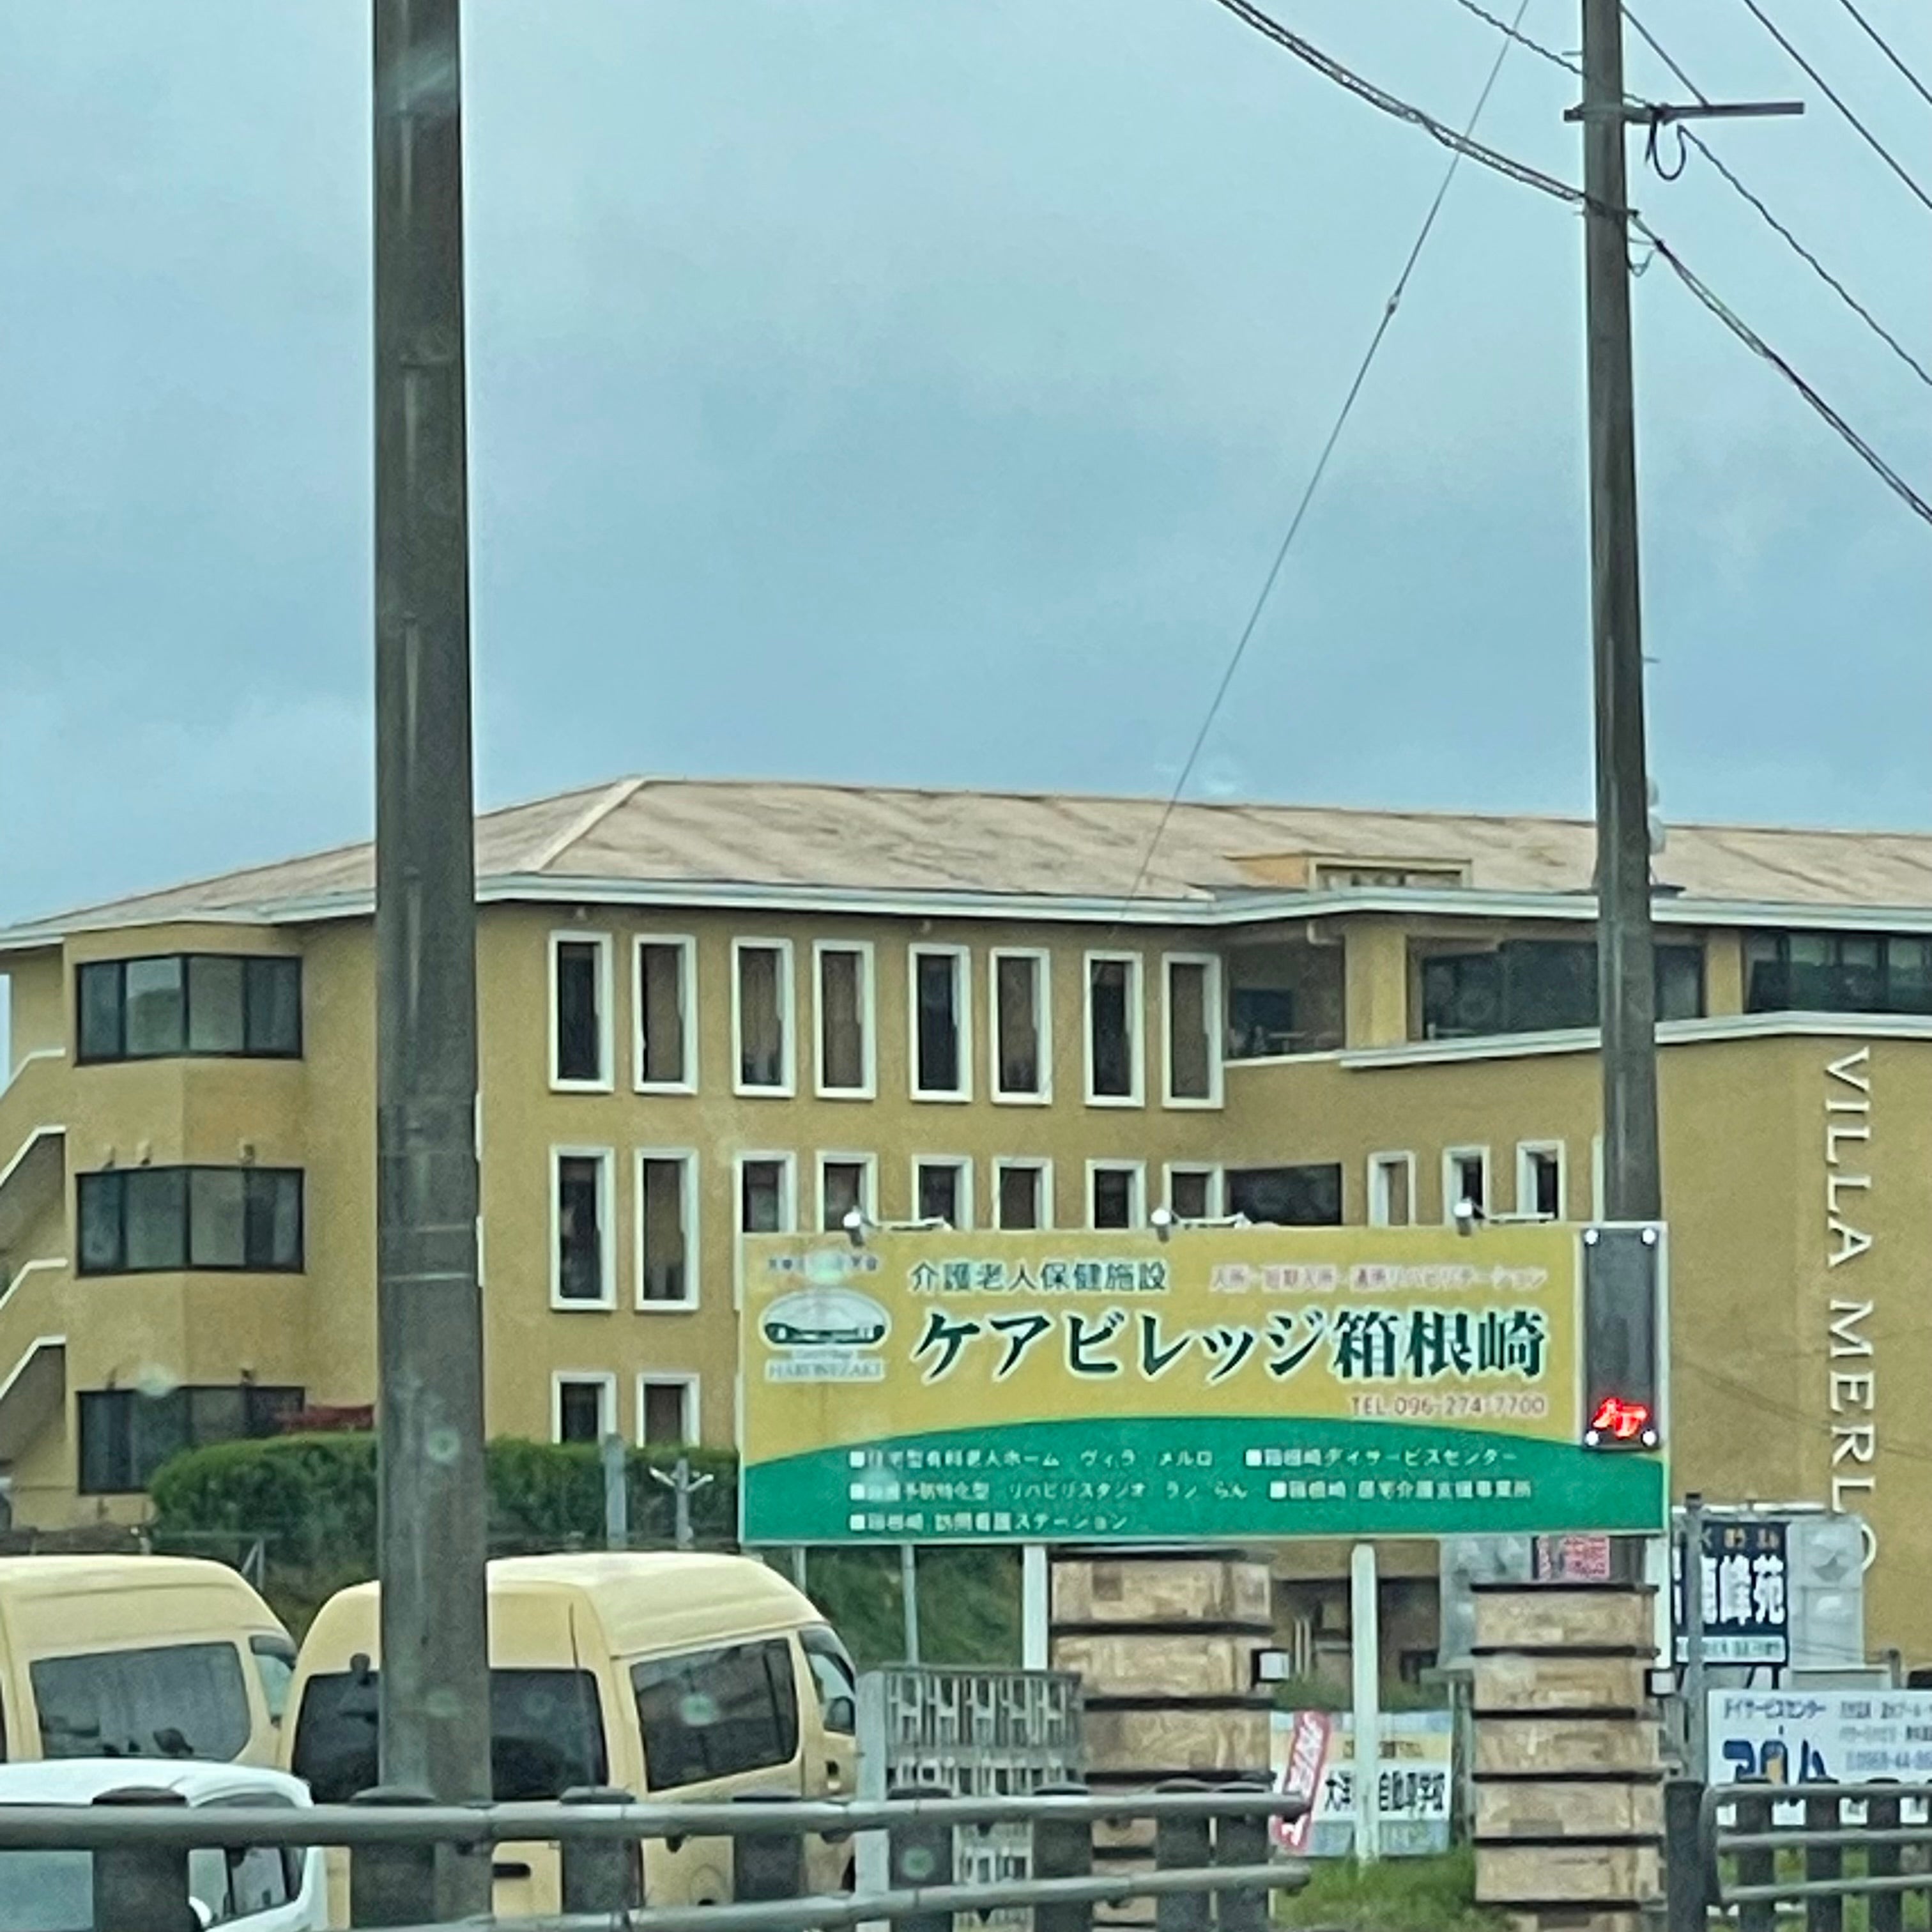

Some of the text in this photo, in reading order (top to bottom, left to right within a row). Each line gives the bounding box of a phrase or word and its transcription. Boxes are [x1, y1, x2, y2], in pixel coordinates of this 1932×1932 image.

[1824, 1046, 1873, 1268] VILLA
[912, 1262, 1167, 1291] 介護老人保健施設
[912, 1307, 1546, 1380] ケアビレッジ箱根崎
